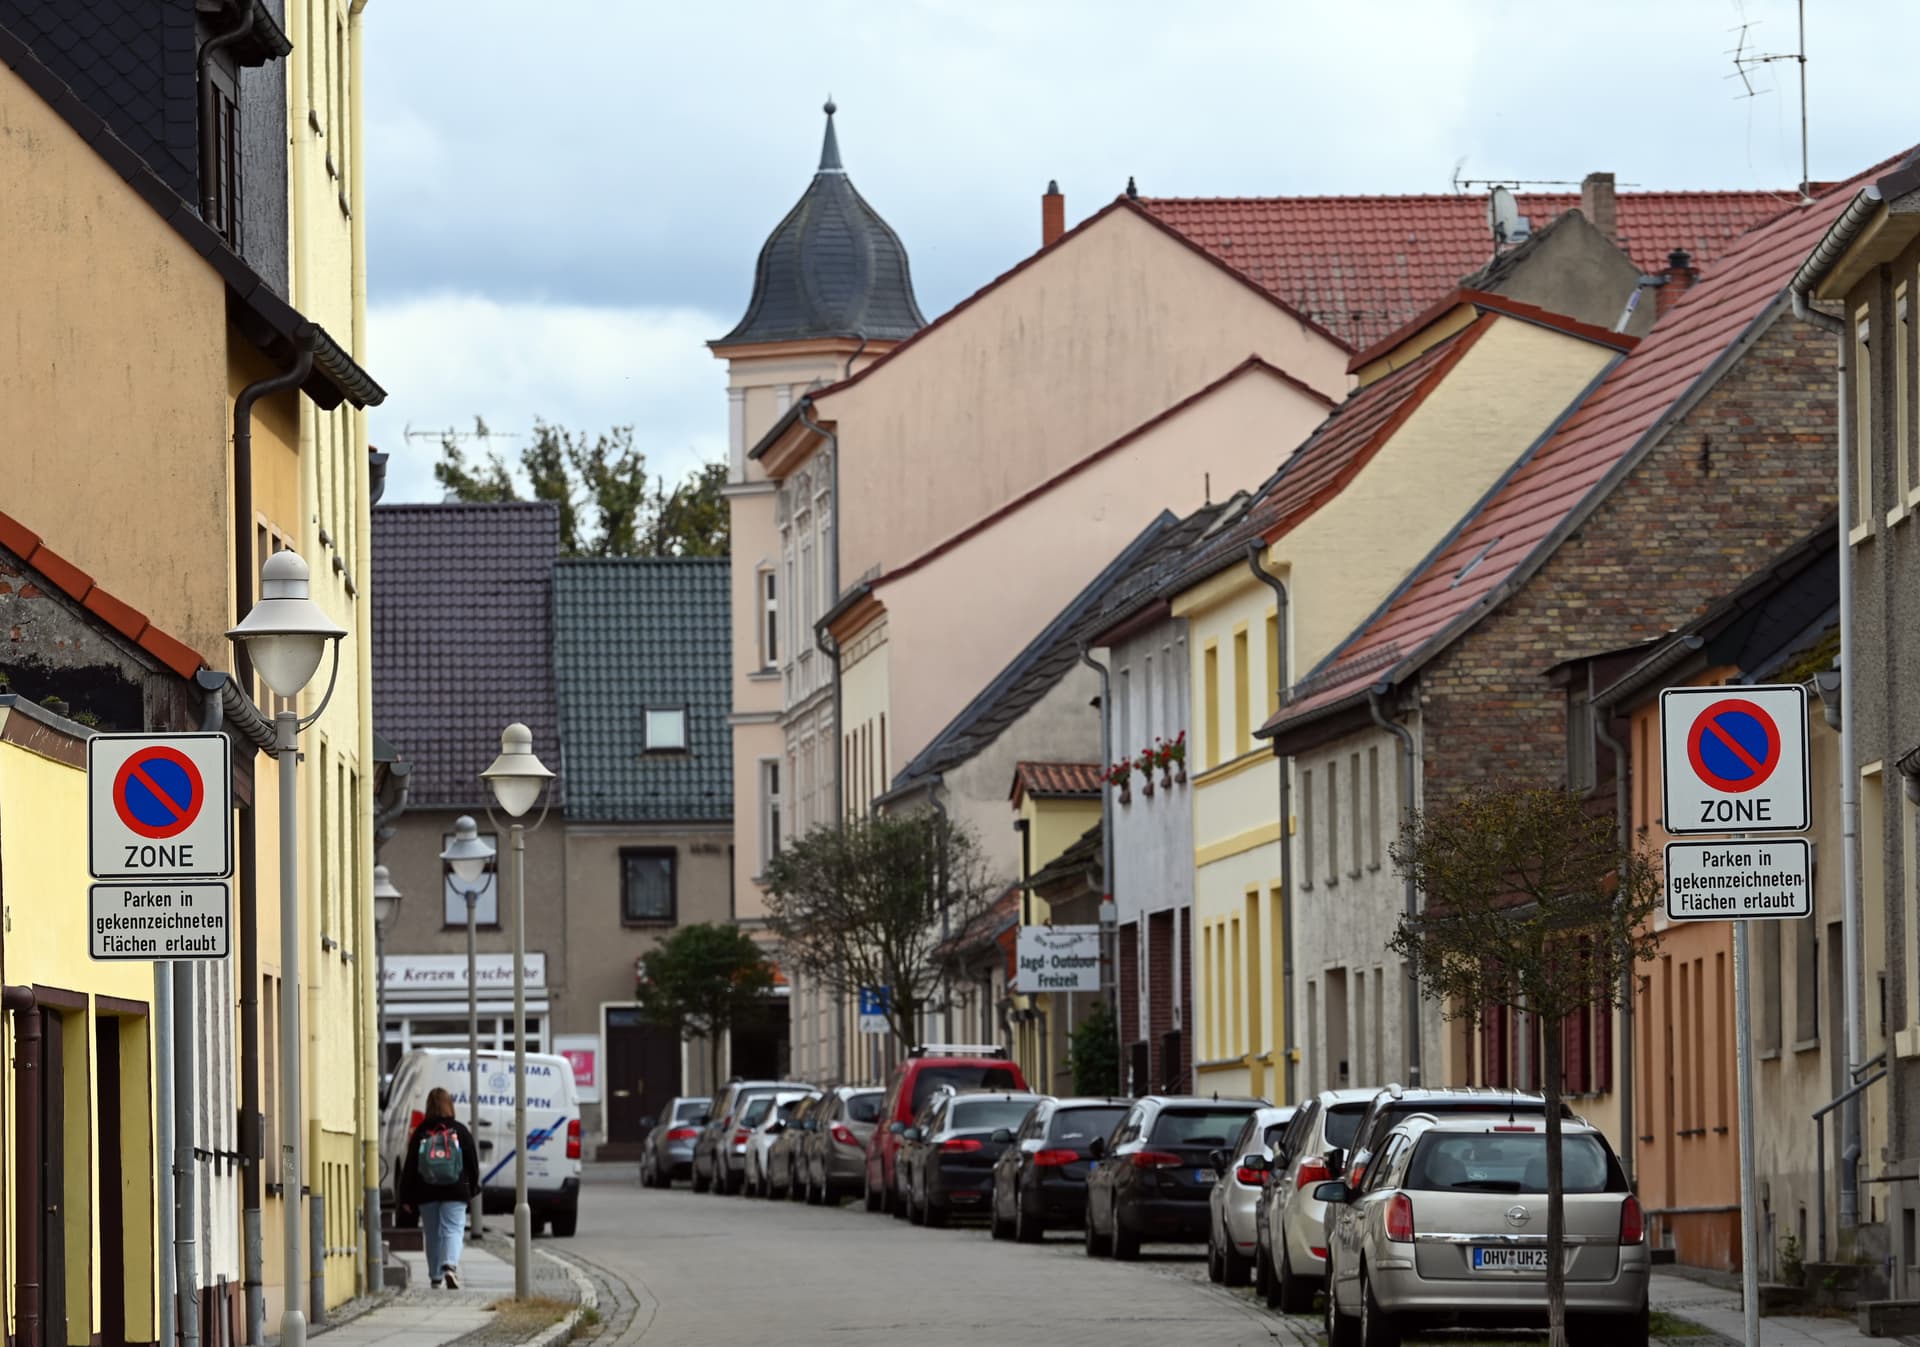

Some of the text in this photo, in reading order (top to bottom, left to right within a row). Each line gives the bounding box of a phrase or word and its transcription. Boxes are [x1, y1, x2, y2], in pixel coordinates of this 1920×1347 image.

[1700, 798, 1772, 823] ZONE
[124, 845, 194, 868] ZONE
[1702, 849, 1771, 868] Parken in
[1673, 870, 1802, 894] gekennzeichneten
[124, 890, 193, 908] Parken in
[1681, 891, 1795, 911] Flächen erlaubt
[96, 912, 223, 934] gekennzeichneten
[103, 934, 217, 952] Flächen erlaubt
[1020, 954, 1096, 973] Jagd Outdoor
[404, 968, 455, 981] Kerzen
[1038, 972, 1079, 988] Freizeit
[508, 1063, 552, 1076] KIMA
[1483, 1250, 1508, 1265] OHV
